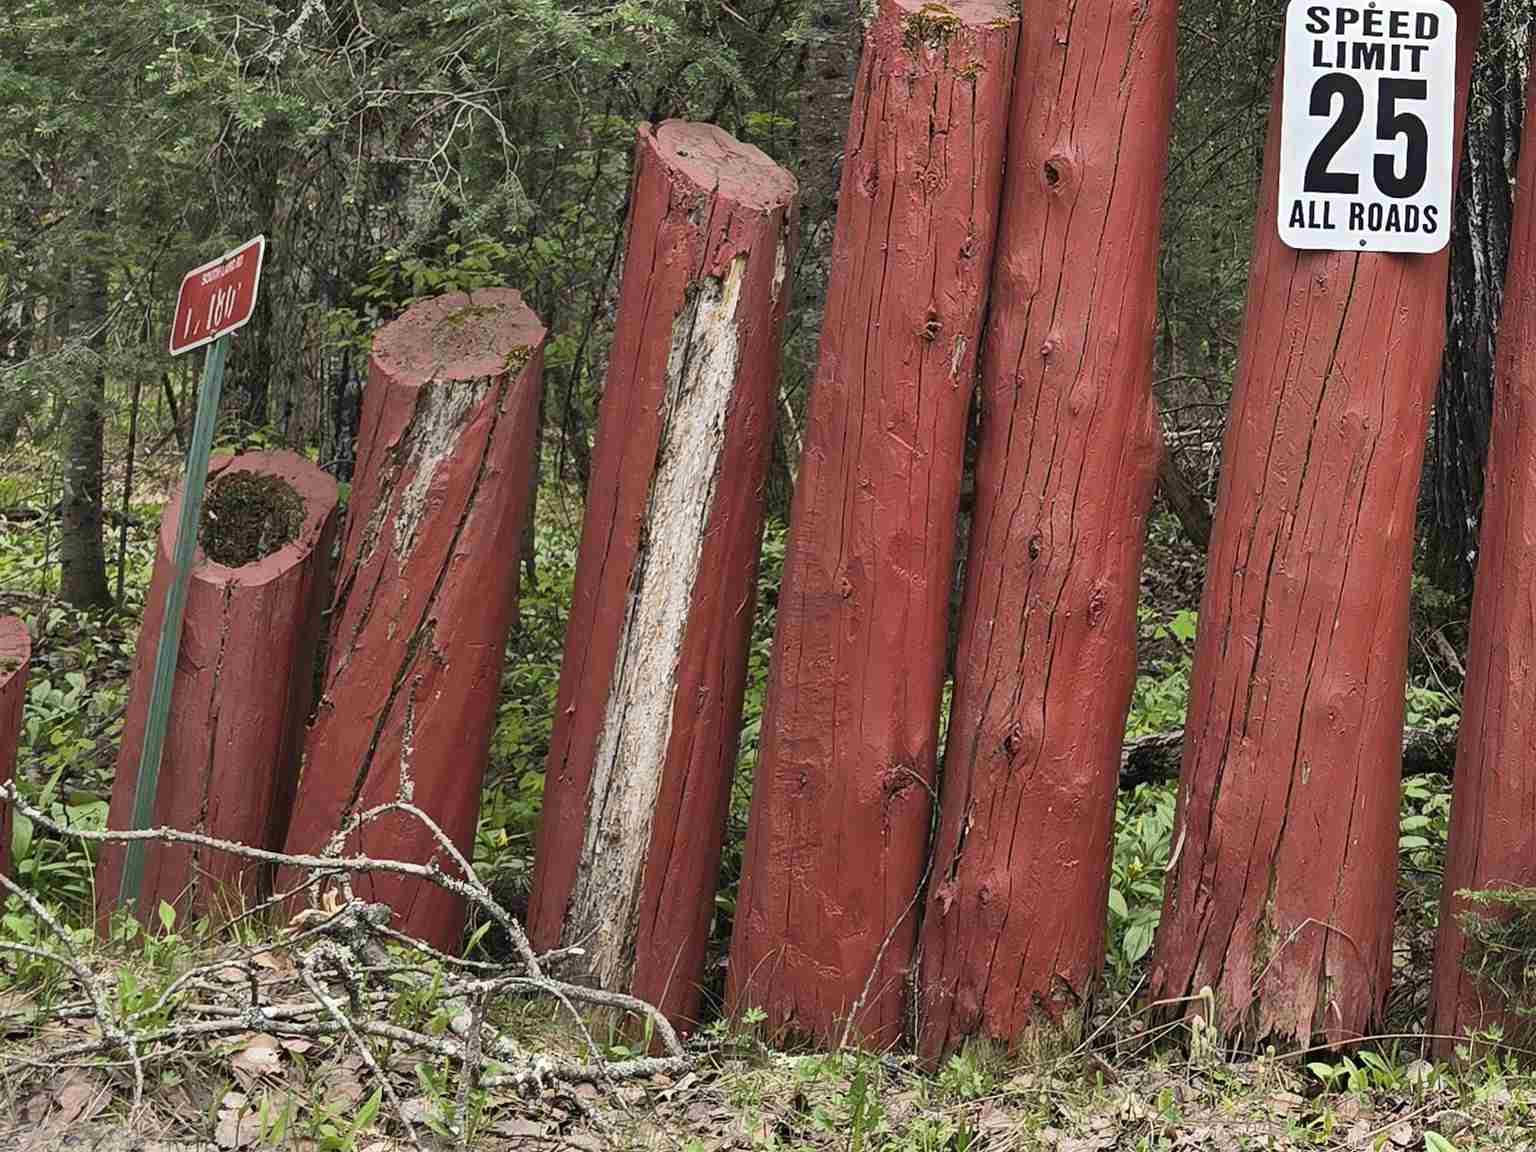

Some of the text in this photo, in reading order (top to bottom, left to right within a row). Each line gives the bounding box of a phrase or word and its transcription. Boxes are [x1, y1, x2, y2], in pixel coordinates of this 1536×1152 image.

[1305, 5, 1440, 41] SPEED
[1312, 40, 1429, 73] LIMIT
[1303, 73, 1429, 199] 25
[1289, 200, 1439, 234] ALL ROADS
